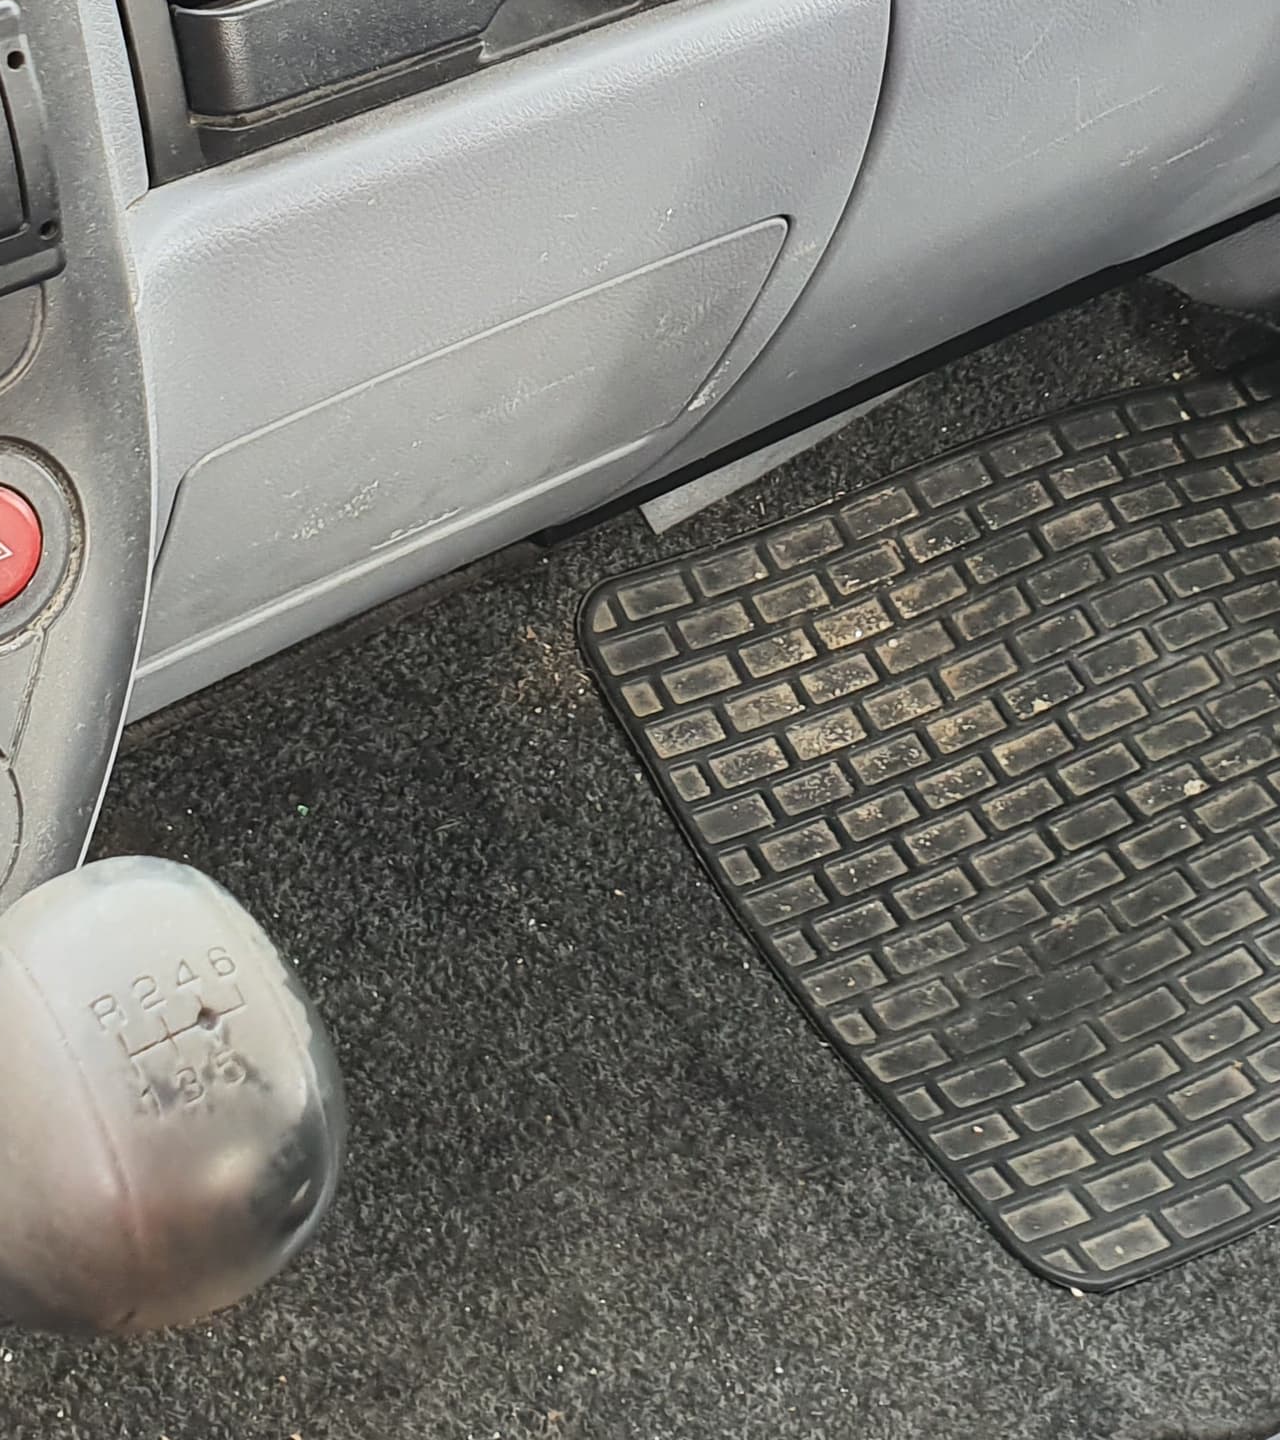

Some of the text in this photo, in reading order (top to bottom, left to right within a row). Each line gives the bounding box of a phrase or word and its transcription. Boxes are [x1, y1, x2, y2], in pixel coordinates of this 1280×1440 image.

[132, 975, 167, 1010] 2
[175, 958, 201, 987] 4
[207, 945, 236, 977] 6
[175, 1066, 205, 1103] 3
